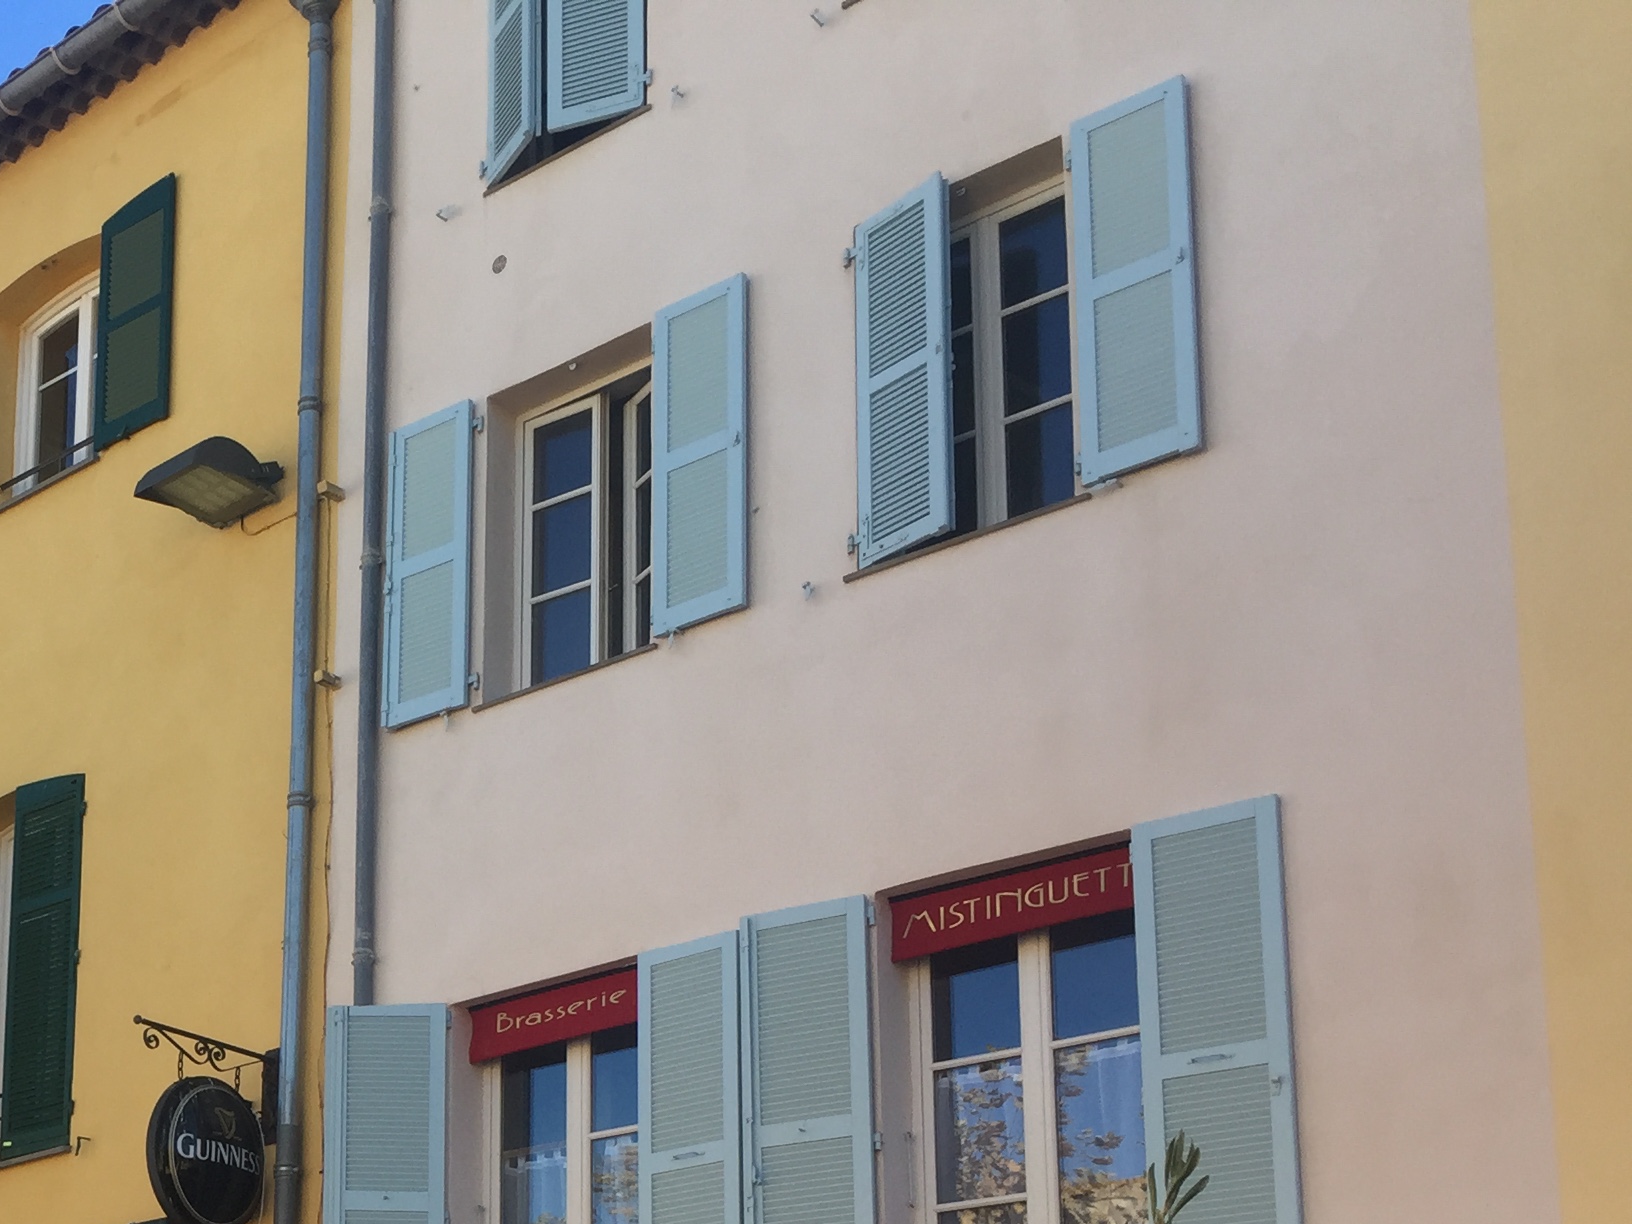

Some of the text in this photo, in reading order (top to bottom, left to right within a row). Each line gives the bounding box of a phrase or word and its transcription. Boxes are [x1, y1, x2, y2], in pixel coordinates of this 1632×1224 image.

[902, 862, 1133, 940] MISTINGUETT
[494, 987, 627, 1035] Brasserie
[176, 1133, 260, 1176] GUINNESS
